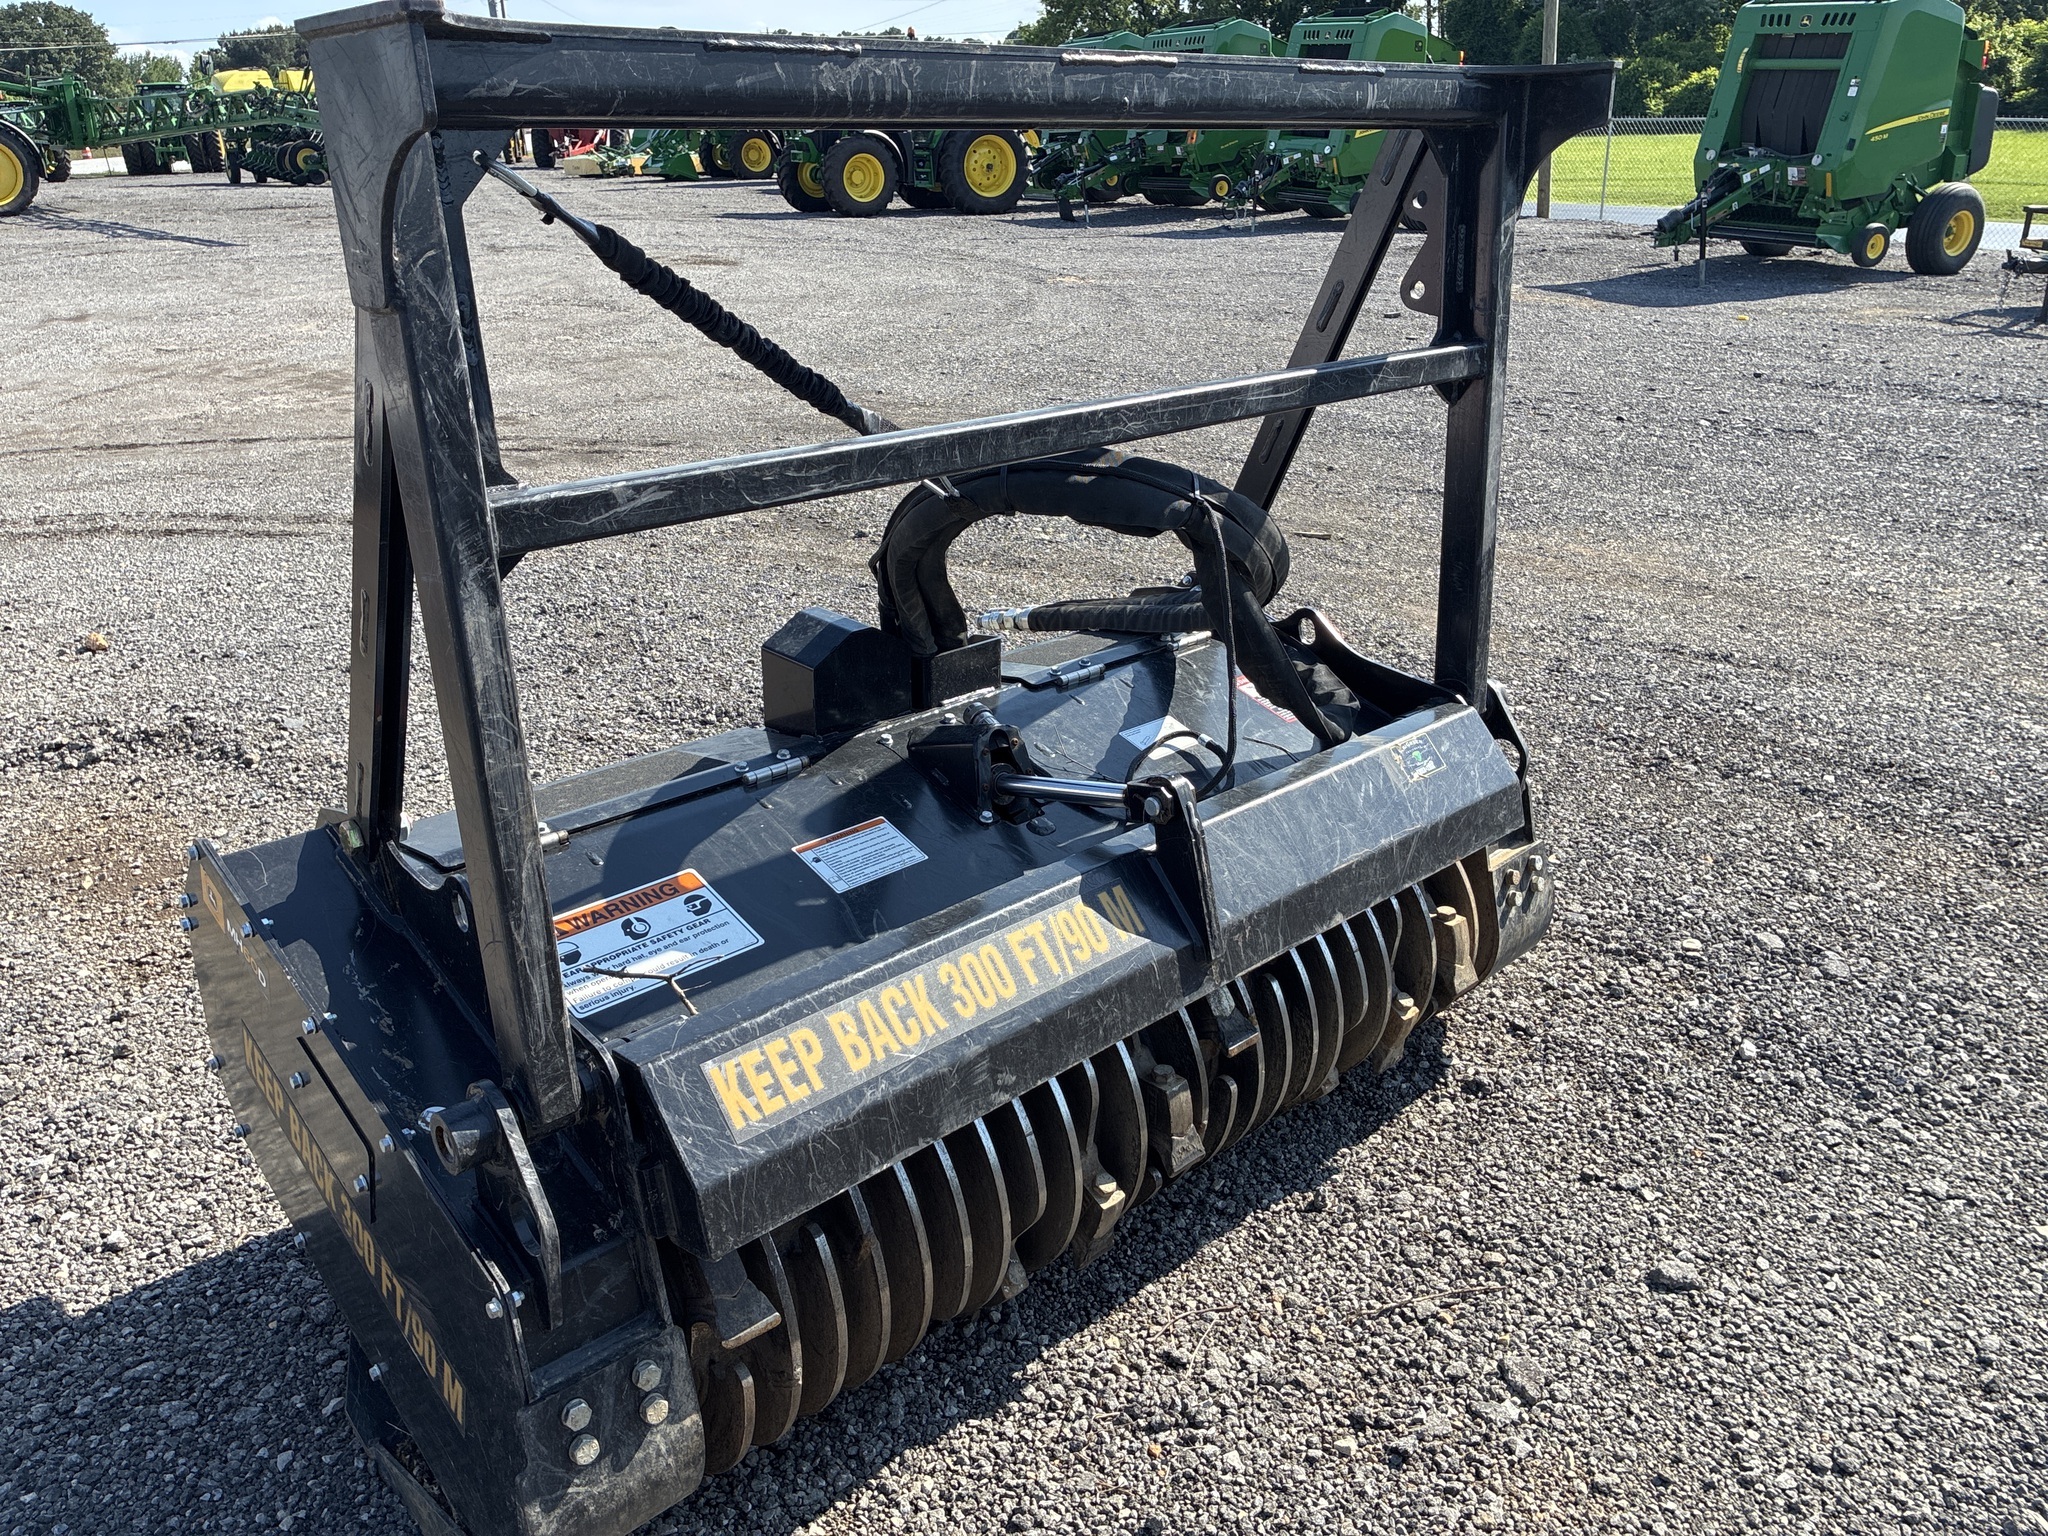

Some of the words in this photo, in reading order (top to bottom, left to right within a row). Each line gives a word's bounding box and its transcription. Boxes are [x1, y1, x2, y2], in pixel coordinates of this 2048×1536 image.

[565, 883, 680, 932] WARNING
[226, 918, 267, 988] MH60D
[563, 966, 584, 979] EAR
[651, 929, 684, 948] SAFETY
[686, 918, 711, 931] GEAR
[572, 990, 602, 1004] Failure
[666, 954, 689, 967] result
[689, 951, 698, 959] in
[698, 943, 720, 955] death
[611, 958, 632, 971] hard
[648, 947, 662, 956] eye
[662, 939, 679, 950] and
[679, 934, 692, 944] ear
[692, 920, 730, 940] protection
[566, 984, 590, 996] when
[578, 994, 611, 1011] serious
[610, 984, 637, 999] injury.
[709, 1027, 826, 1130] KEEP
[828, 977, 950, 1073] BACK
[938, 943, 1017, 1019] 300
[1007, 902, 1110, 987] FT/90
[1098, 884, 1145, 942] M
[242, 1026, 284, 1118] KEEP
[289, 1116, 338, 1213] BACK
[340, 1194, 376, 1277] 300
[380, 1255, 437, 1379] FT/90
[441, 1359, 464, 1424] M
